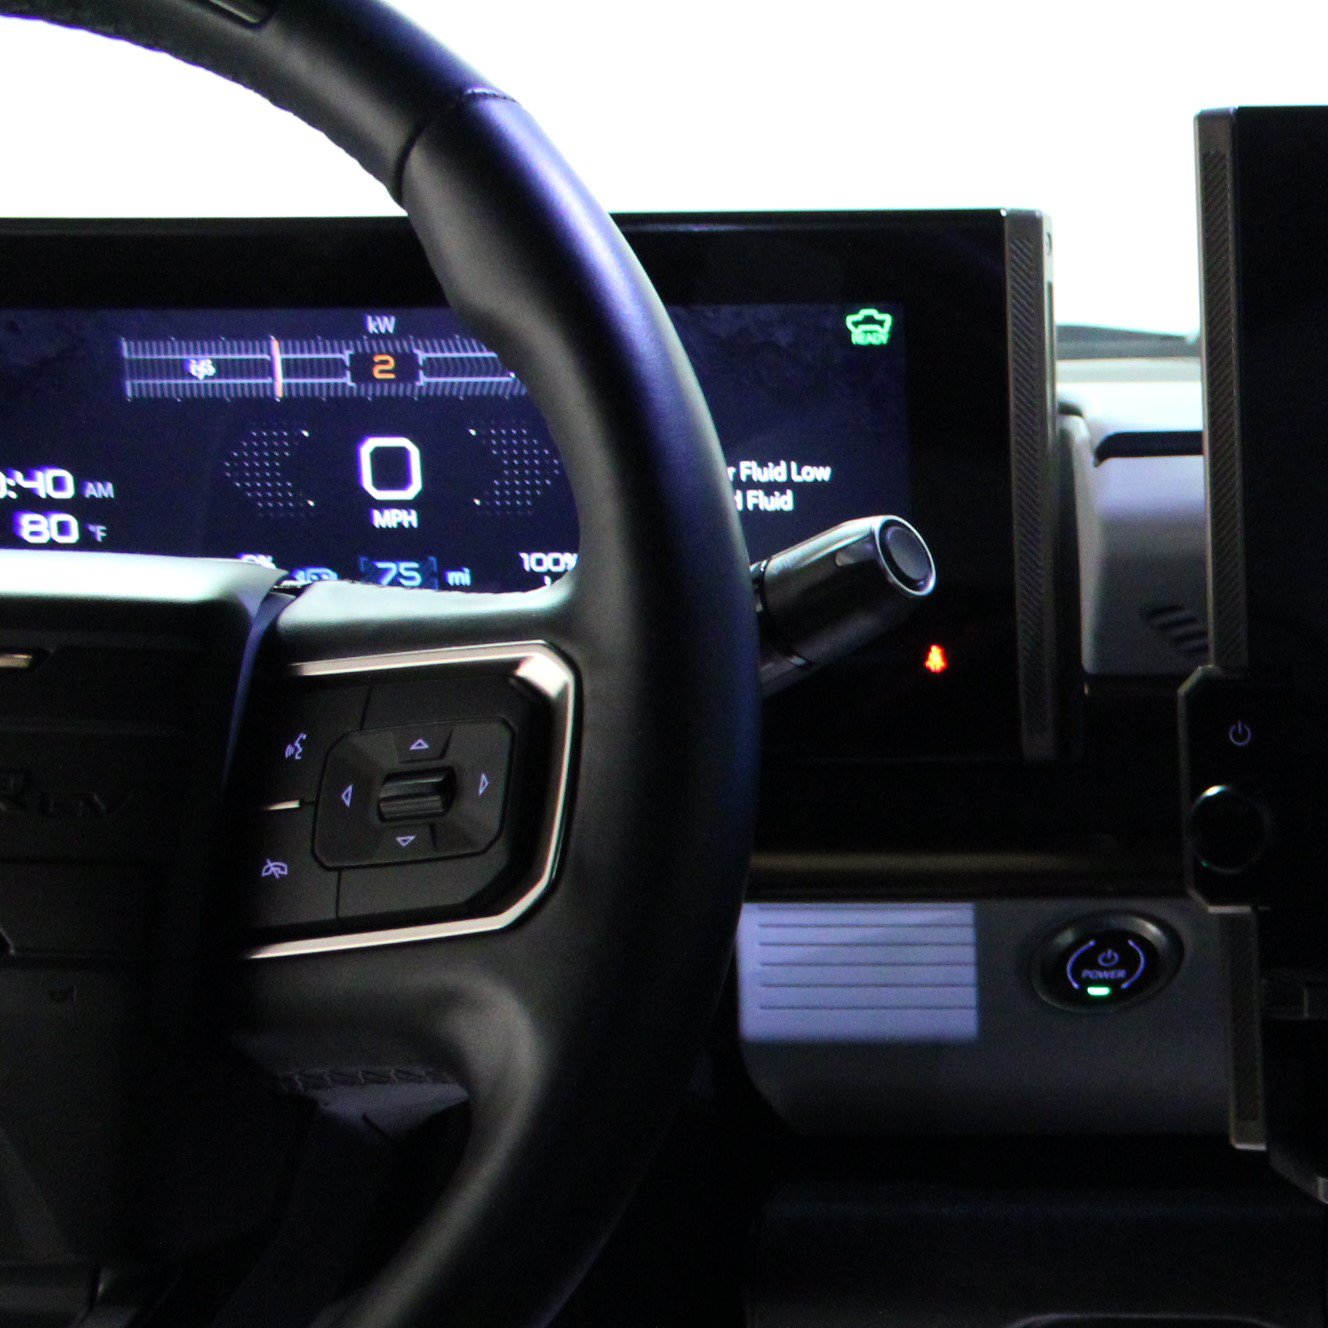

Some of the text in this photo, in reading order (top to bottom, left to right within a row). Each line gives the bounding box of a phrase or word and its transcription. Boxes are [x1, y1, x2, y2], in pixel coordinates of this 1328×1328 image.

[359, 436, 422, 500] 0
[740, 460, 788, 482] Fluid
[791, 461, 832, 482] Low
[83, 480, 115, 499] AM
[746, 489, 794, 511] Fluid
[18, 511, 80, 544] 80
[370, 509, 418, 528] MPH
[375, 561, 471, 586] 75 mi
